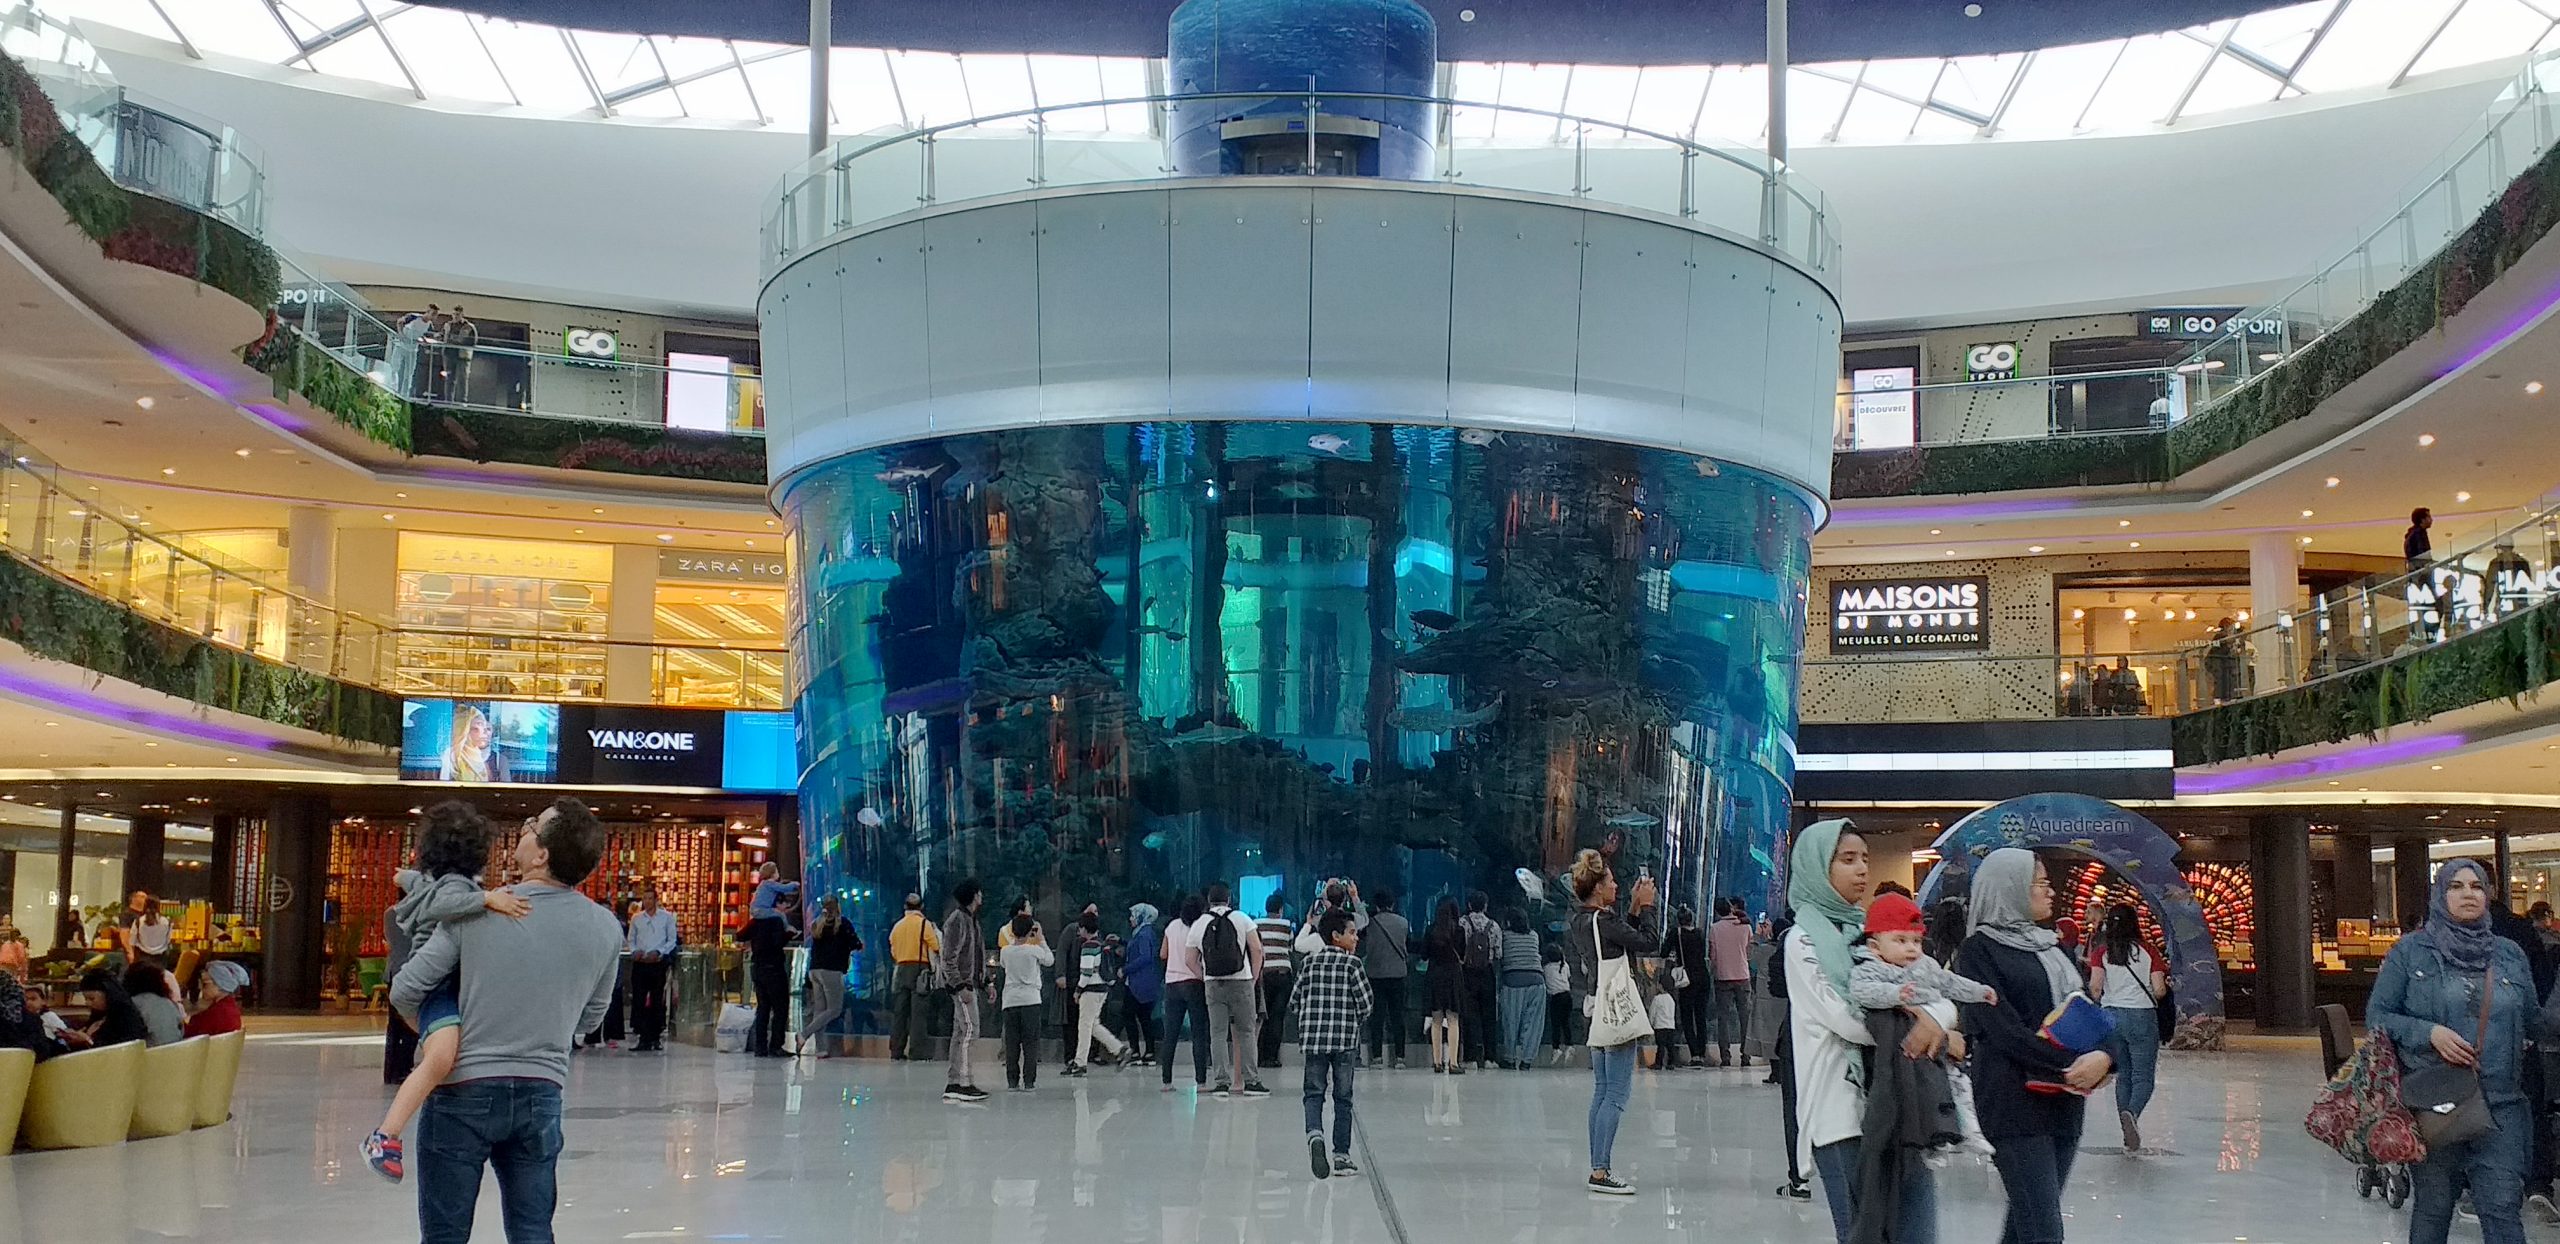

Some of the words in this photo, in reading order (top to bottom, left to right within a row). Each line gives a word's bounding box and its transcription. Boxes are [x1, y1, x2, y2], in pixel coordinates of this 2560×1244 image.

[2152, 317, 2169, 328] GO
[2184, 317, 2217, 333] GO
[568, 329, 615, 356] GO
[1968, 344, 2016, 370] GO
[1874, 375, 1893, 389] GO
[1969, 371, 2014, 381] SPORT
[1860, 405, 1906, 414] DÉCOUVREZ
[432, 549, 499, 563] ZARA
[678, 558, 741, 574] ZARA
[1839, 584, 1979, 610] MAISONS
[1838, 615, 1869, 630] DU
[1888, 612, 1979, 628] MONDE
[1838, 635, 1889, 645] MEUBLES
[1894, 635, 1902, 643] &
[1906, 633, 1979, 644] DÉCORATION
[587, 730, 694, 750] YAN&ONE
[605, 753, 675, 761] CASABLANCA
[2028, 817, 2132, 835] Aquadream
